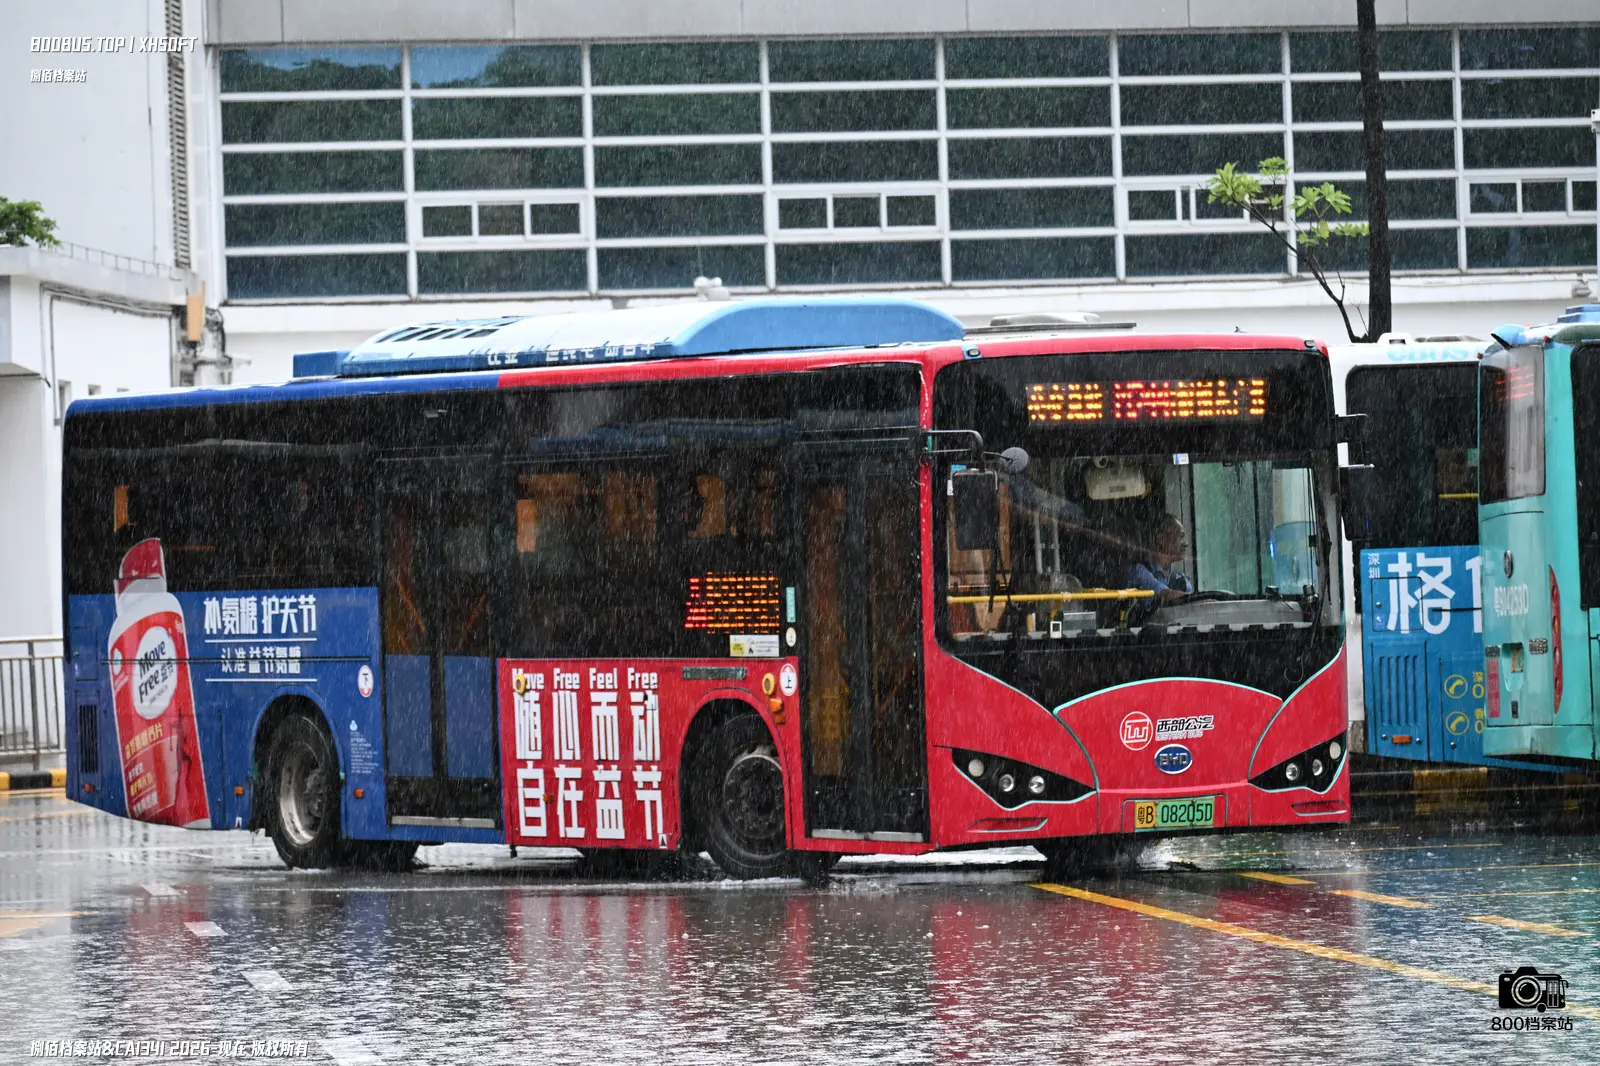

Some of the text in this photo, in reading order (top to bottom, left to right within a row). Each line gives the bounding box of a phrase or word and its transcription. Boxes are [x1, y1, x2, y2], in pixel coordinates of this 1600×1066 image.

[261, 594, 317, 635] 护关节
[138, 641, 167, 679] Move
[553, 667, 580, 689] Free
[589, 667, 618, 689] Feel
[627, 667, 658, 689] Free
[138, 669, 160, 704] Free
[513, 690, 661, 761] 随心而动
[1156, 715, 1214, 733] 西部公汽
[1159, 753, 1189, 766] BYD
[516, 761, 664, 840] 自在益节
